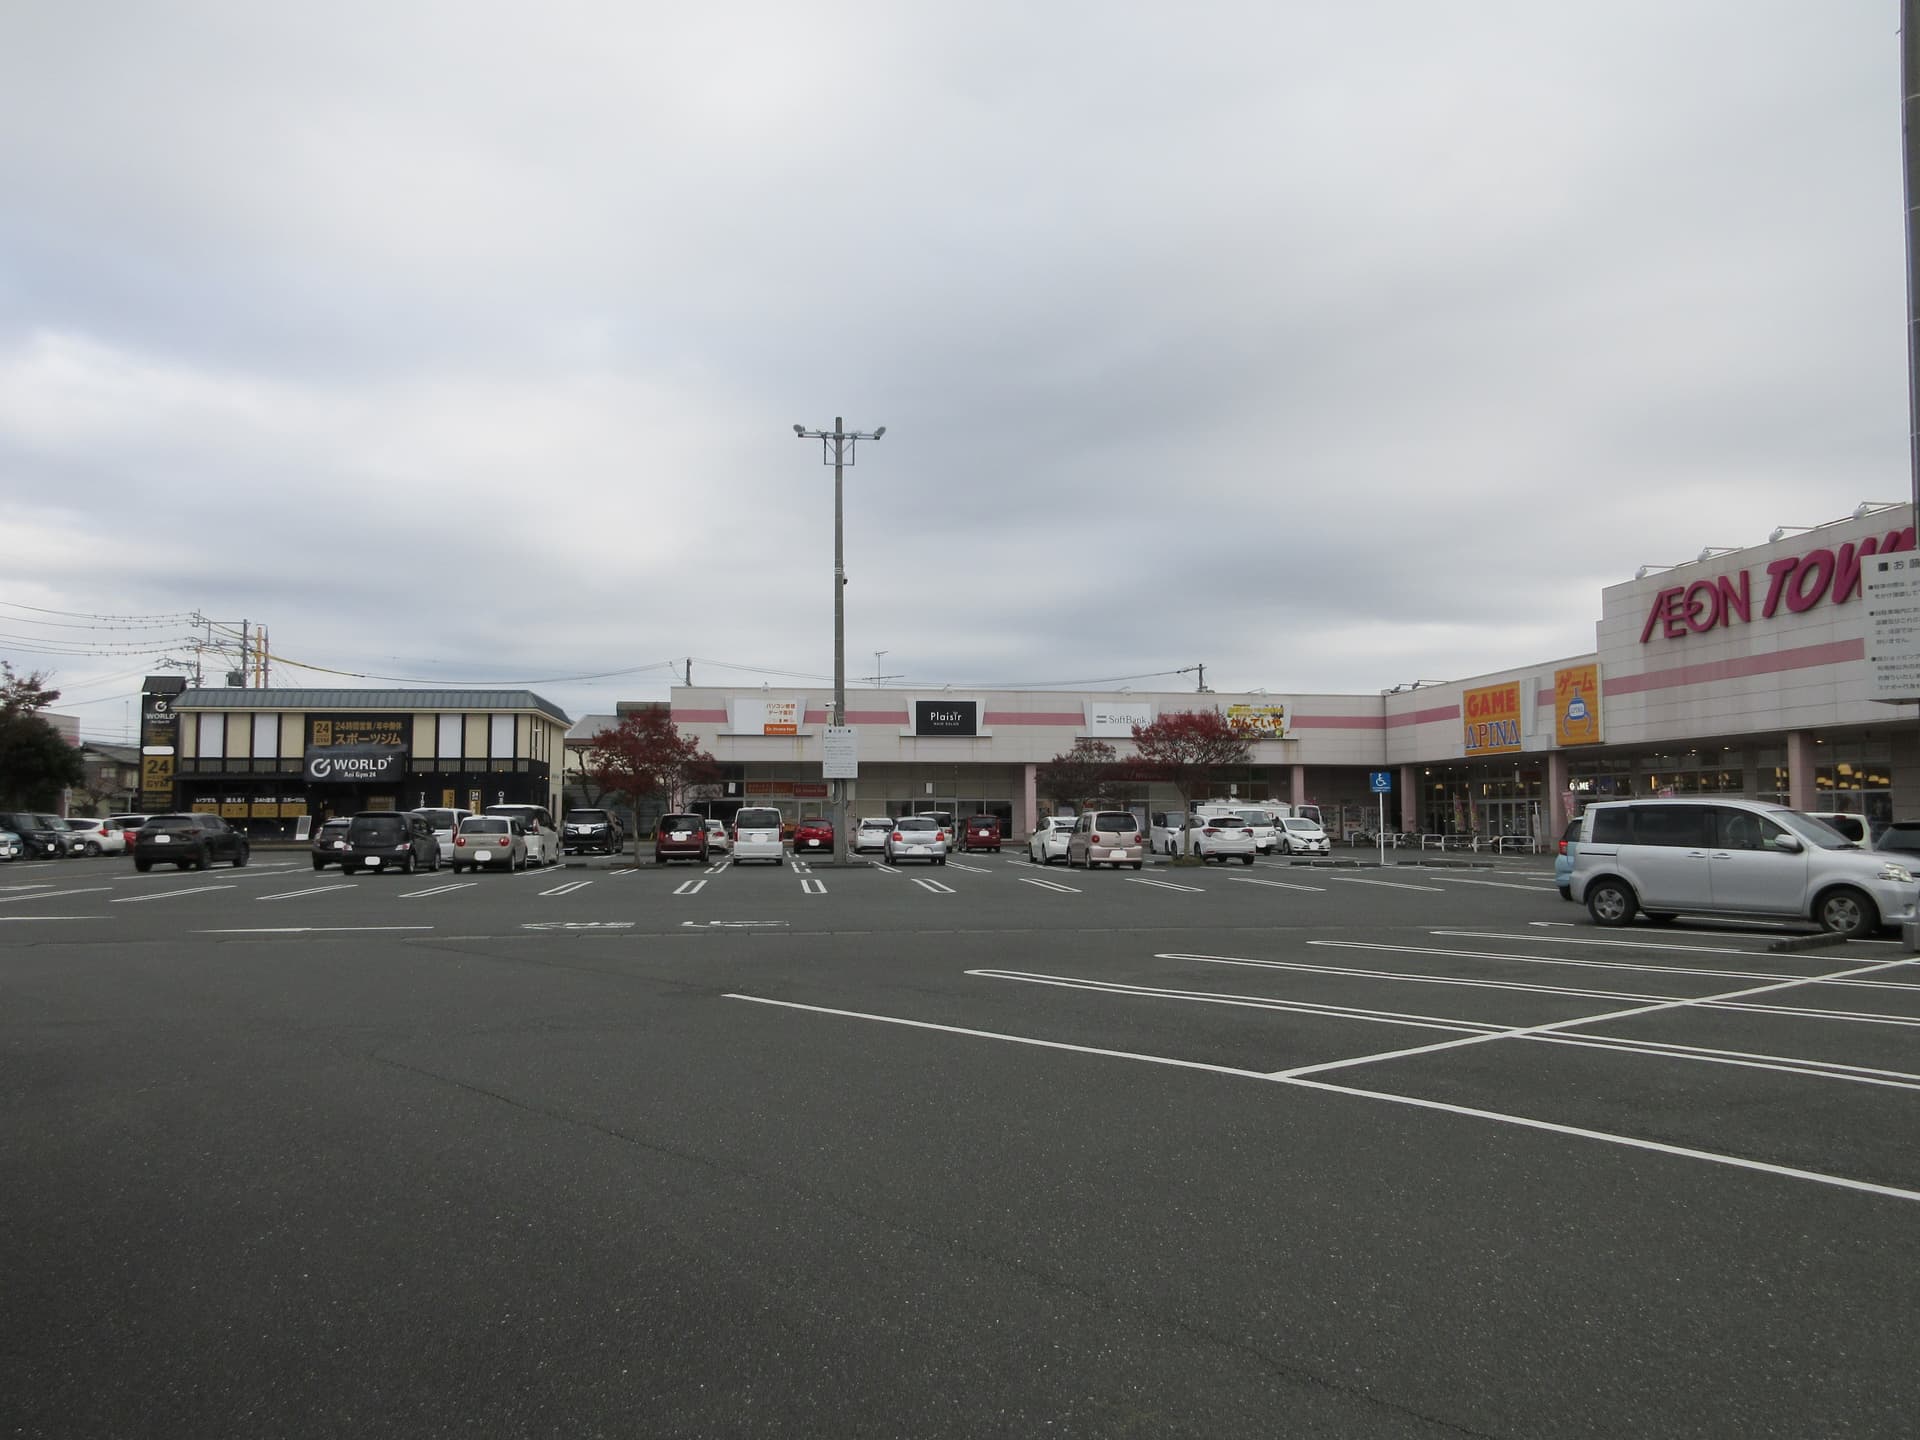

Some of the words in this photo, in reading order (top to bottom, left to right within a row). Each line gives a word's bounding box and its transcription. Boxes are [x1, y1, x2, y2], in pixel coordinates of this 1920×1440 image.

[1559, 671, 1594, 696] ゲーム
[1467, 688, 1516, 717] GAME
[316, 723, 329, 733] 24
[1465, 719, 1520, 748] APINA
[336, 733, 401, 744] スポーツジム
[147, 760, 169, 774] 24
